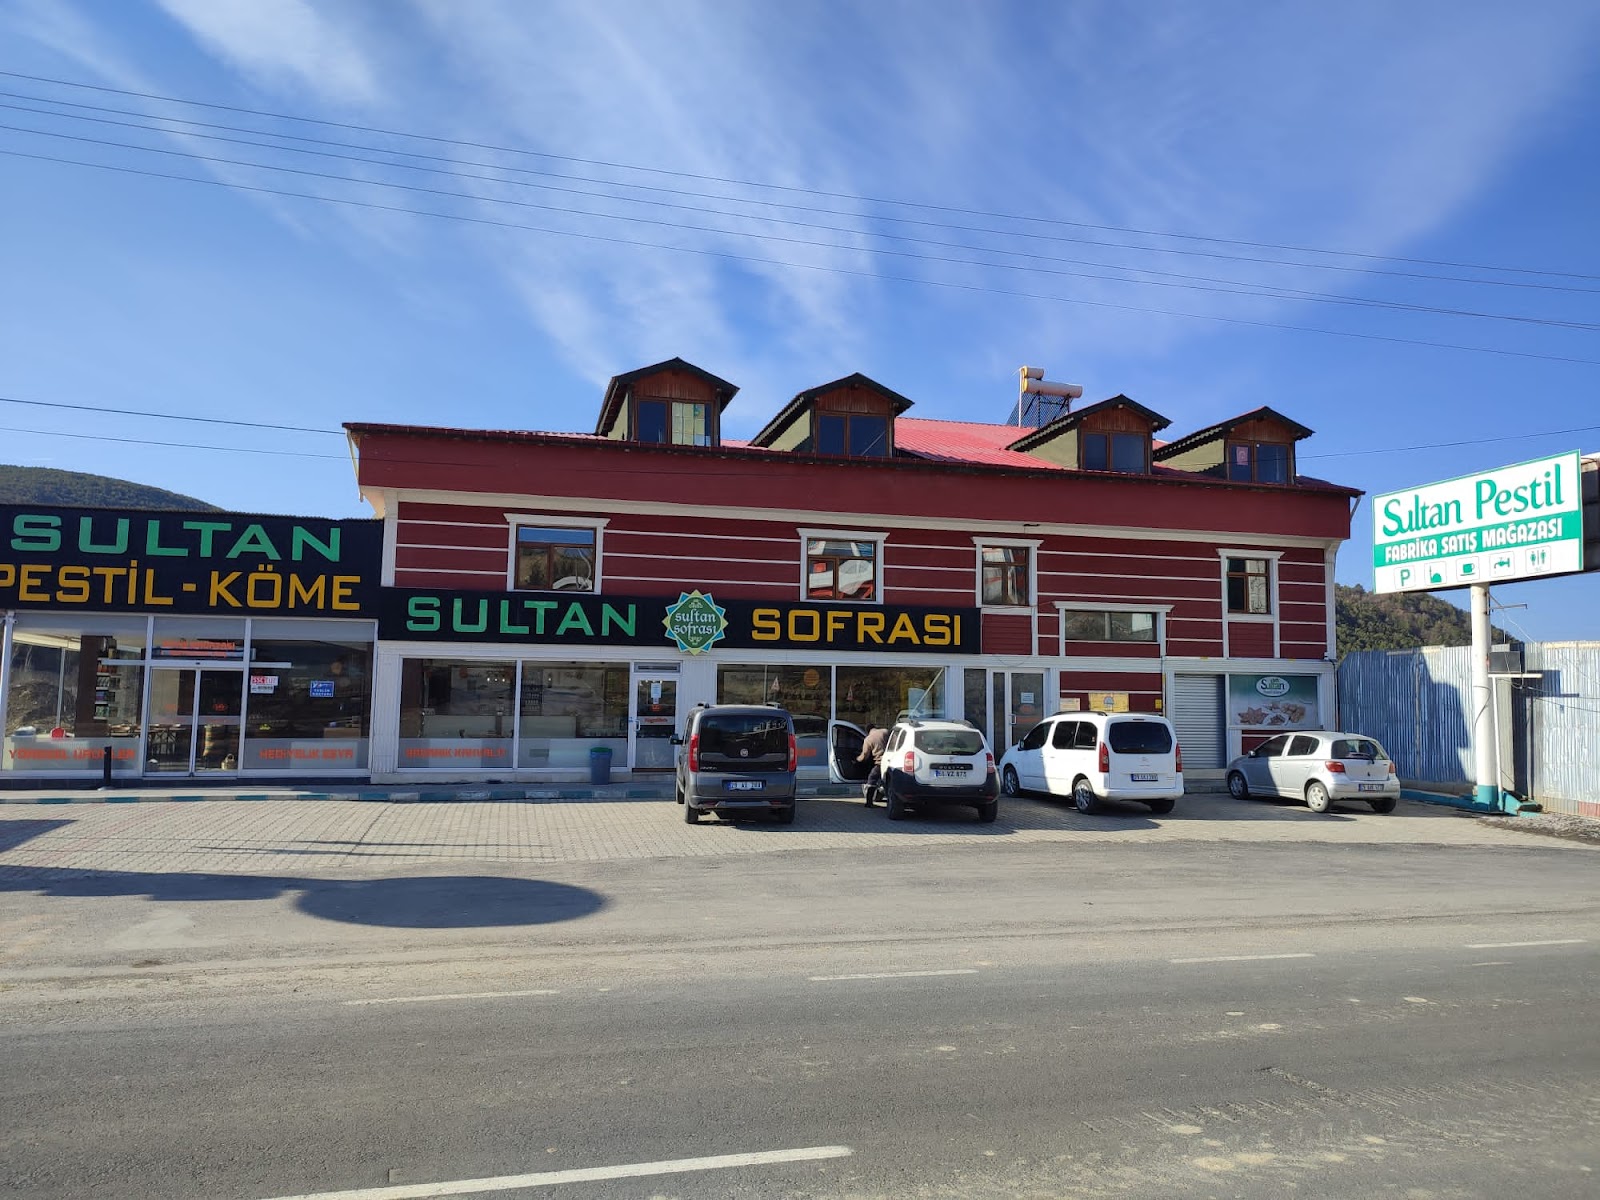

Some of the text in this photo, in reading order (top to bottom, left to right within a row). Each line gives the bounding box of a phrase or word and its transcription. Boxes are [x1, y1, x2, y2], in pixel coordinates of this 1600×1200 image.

[1383, 463, 1565, 537] Sultan Pestil
[11, 514, 340, 562] SULTAN
[1385, 517, 1562, 562] FABRİKA SATIŞ MAĞAZASI
[209, 564, 361, 611] KÖME
[406, 597, 961, 646] SULTAN SOFRASI
[675, 608, 716, 622] sultan
